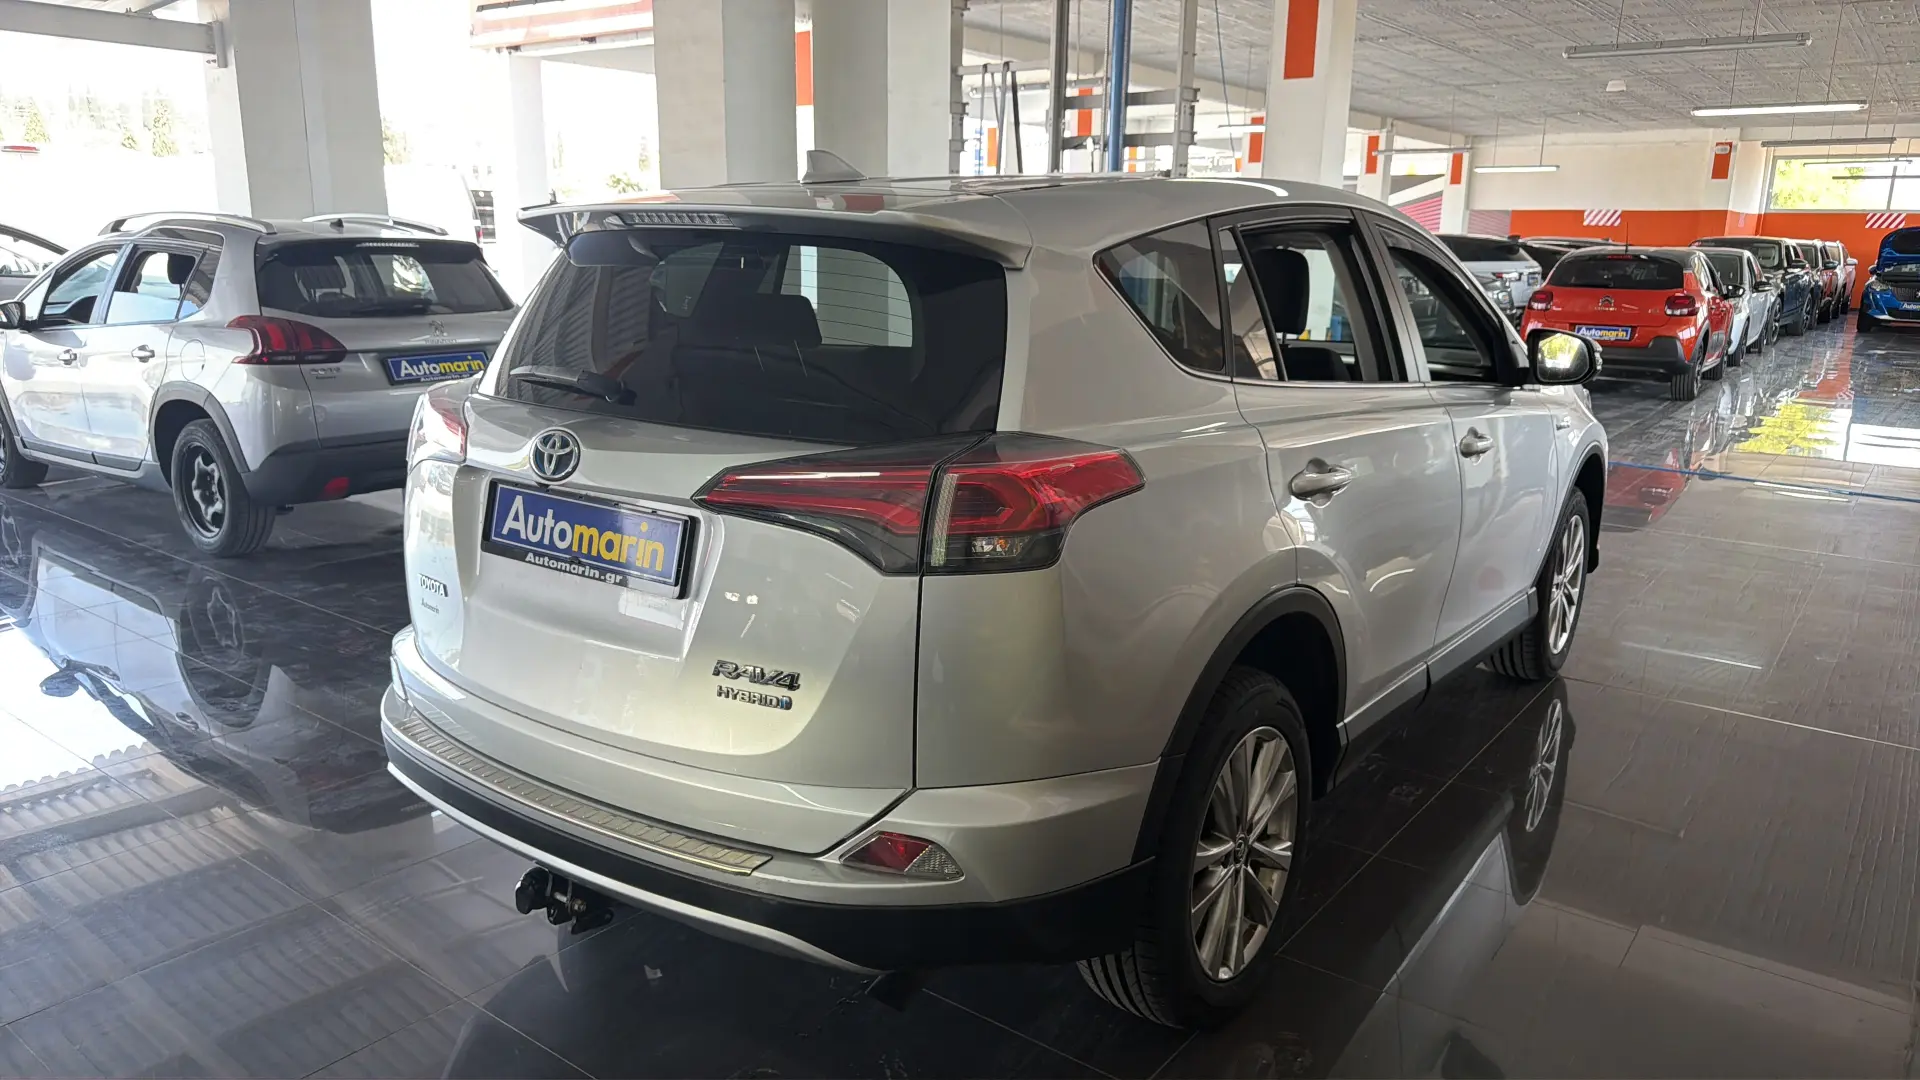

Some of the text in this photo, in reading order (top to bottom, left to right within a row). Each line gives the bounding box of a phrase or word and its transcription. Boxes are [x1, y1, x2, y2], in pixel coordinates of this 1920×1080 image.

[1580, 326, 1627, 337] Automarin
[400, 355, 485, 377] Automarin
[501, 494, 665, 572] Automarin
[525, 551, 623, 584] Automarin.gr
[417, 573, 448, 597] TOYOTA
[712, 659, 801, 691] RAV4
[716, 684, 780, 709] HYBRID
